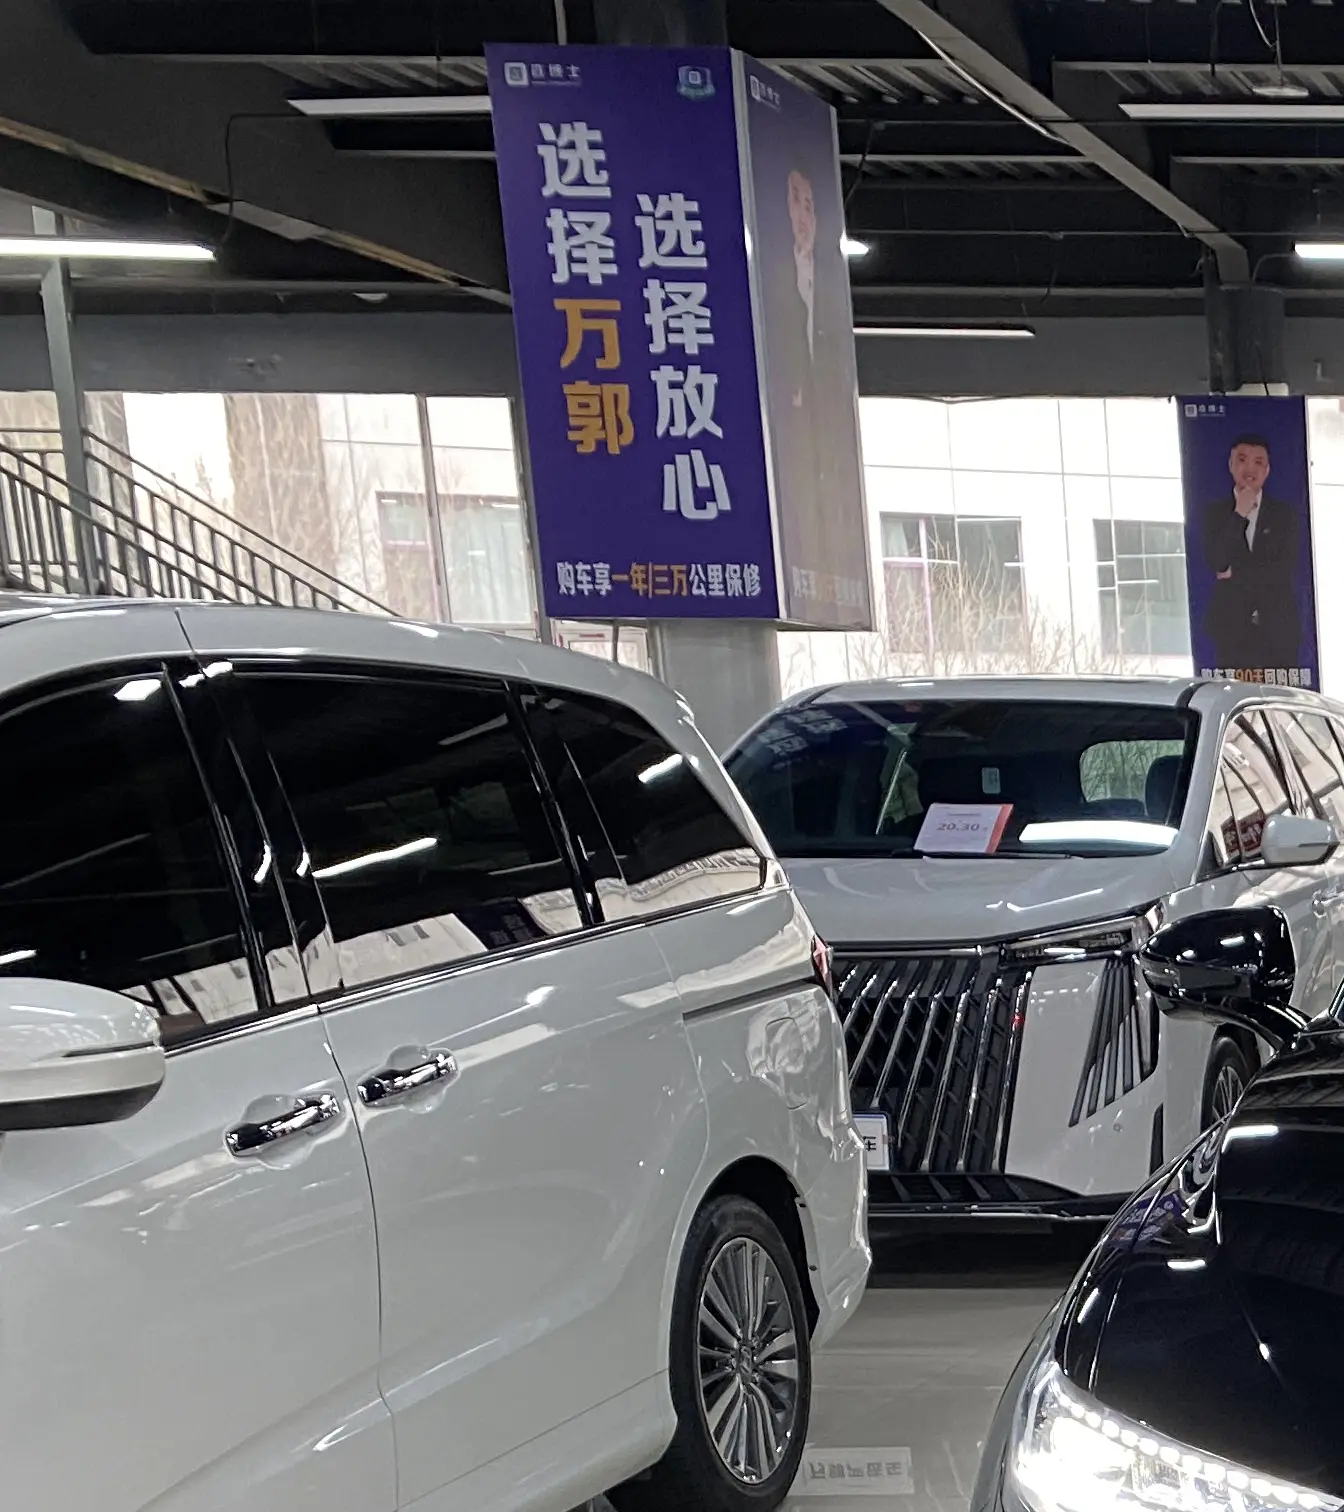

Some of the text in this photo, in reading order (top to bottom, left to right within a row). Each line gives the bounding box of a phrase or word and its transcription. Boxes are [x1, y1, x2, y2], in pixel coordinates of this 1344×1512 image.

[536, 121, 636, 456] 选择万郭
[633, 192, 732, 521] 选择放心
